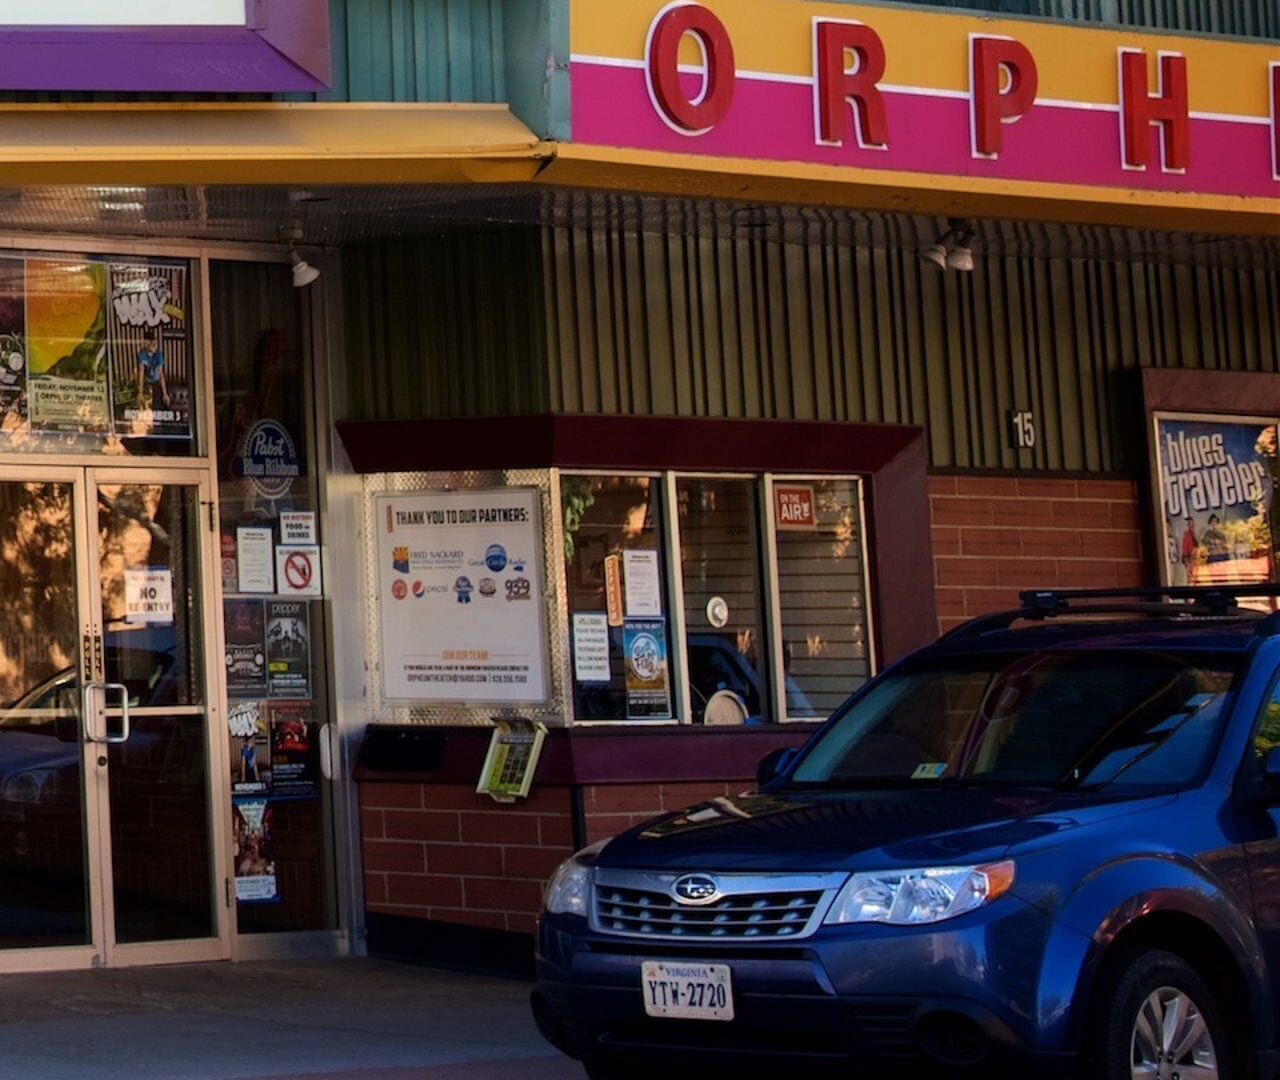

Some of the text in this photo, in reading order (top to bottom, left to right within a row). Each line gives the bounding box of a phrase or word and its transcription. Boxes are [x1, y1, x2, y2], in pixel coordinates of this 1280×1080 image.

[112, 289, 171, 327] WAX
[59, 384, 95, 393] NOVEMBER
[1013, 411, 1036, 447] 15
[251, 430, 286, 457] Pabst
[1166, 431, 1226, 474] blues
[242, 458, 300, 477] Blue Ribbon
[1163, 454, 1266, 519] traveler
[780, 493, 800, 504] ON THE
[396, 507, 530, 526] THANK YOU TO OUR PARTNERS:
[781, 503, 802, 521] AIR
[285, 522, 304, 530] FOOD
[287, 531, 310, 539] DRINKS
[140, 587, 158, 600] NO
[426, 583, 449, 594] pepsi
[128, 602, 171, 612] RE-ENTRY
[665, 967, 709, 978] VIRGINIA
[648, 980, 727, 1008] YTW-2720
